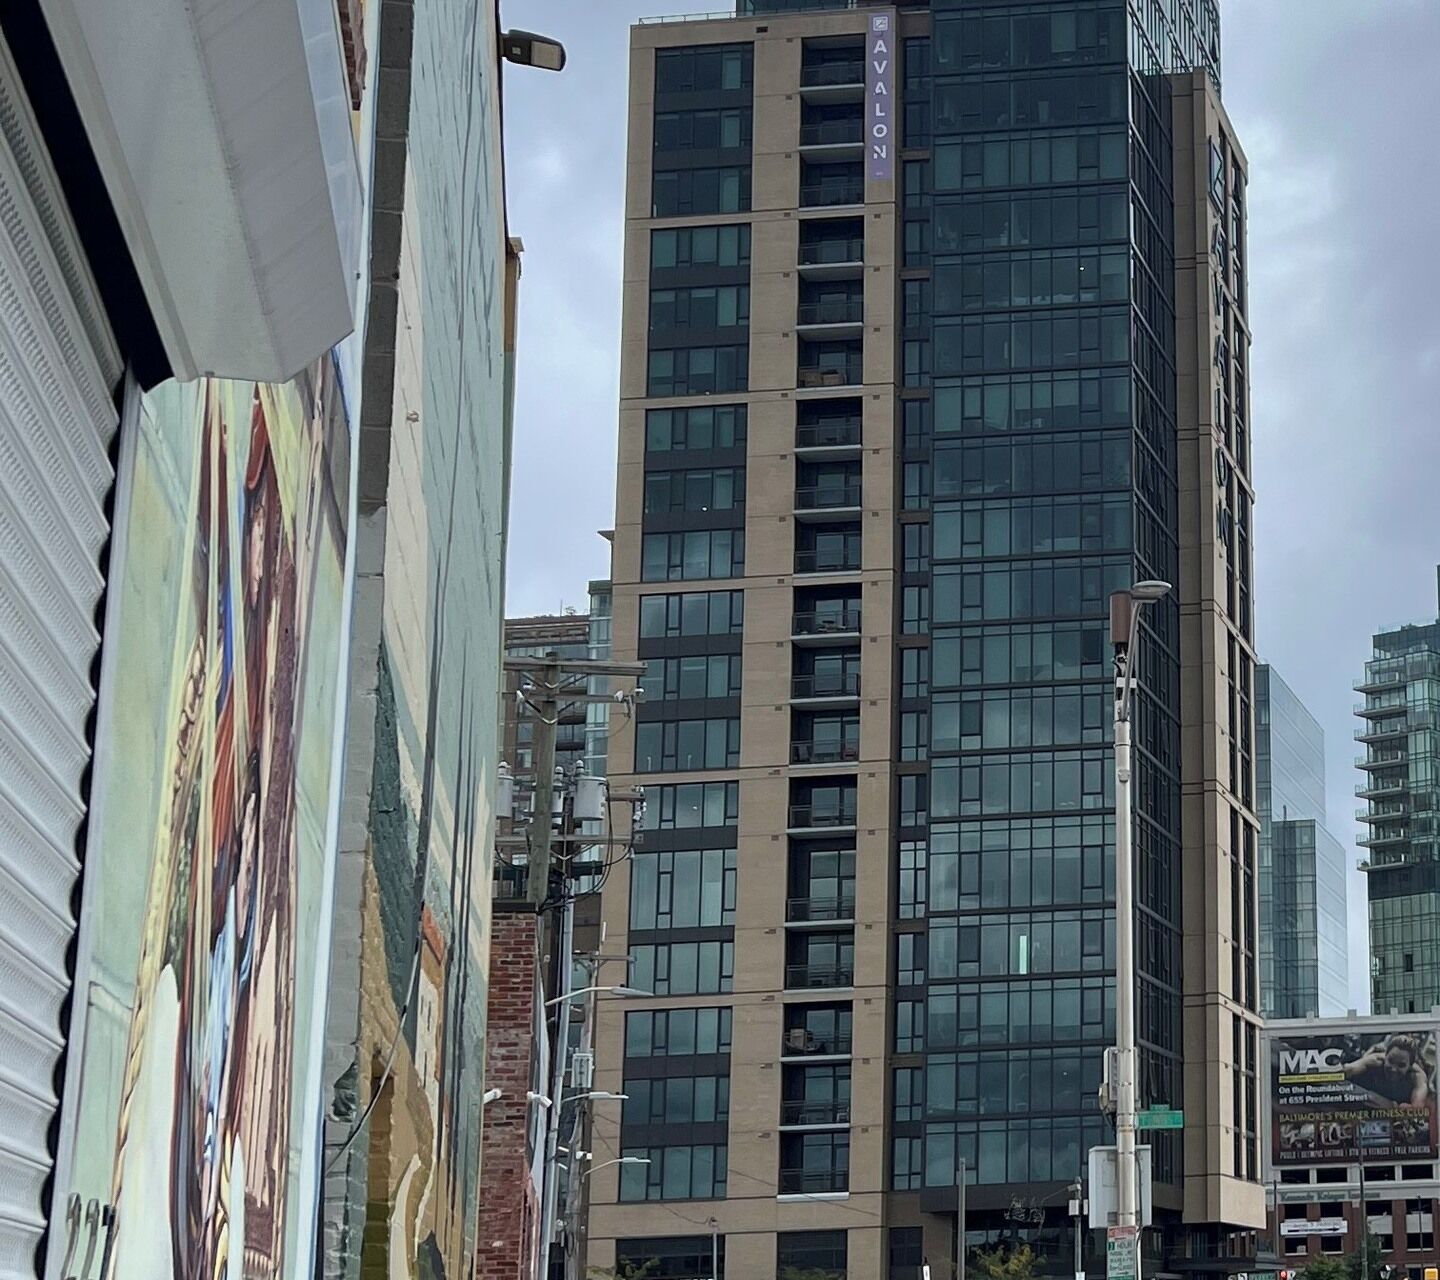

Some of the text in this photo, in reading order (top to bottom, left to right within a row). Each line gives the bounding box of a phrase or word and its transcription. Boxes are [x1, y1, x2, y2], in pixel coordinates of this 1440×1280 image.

[873, 39, 888, 160] AVALON
[1280, 1048, 1344, 1074] MAC
[1279, 1083, 1354, 1095] On the Roundabout
[1306, 1094, 1343, 1103] President
[1344, 1093, 1368, 1102] Street
[1280, 1107, 1430, 1122] BALTIMORE'S PREMIER FITNESS CLUB
